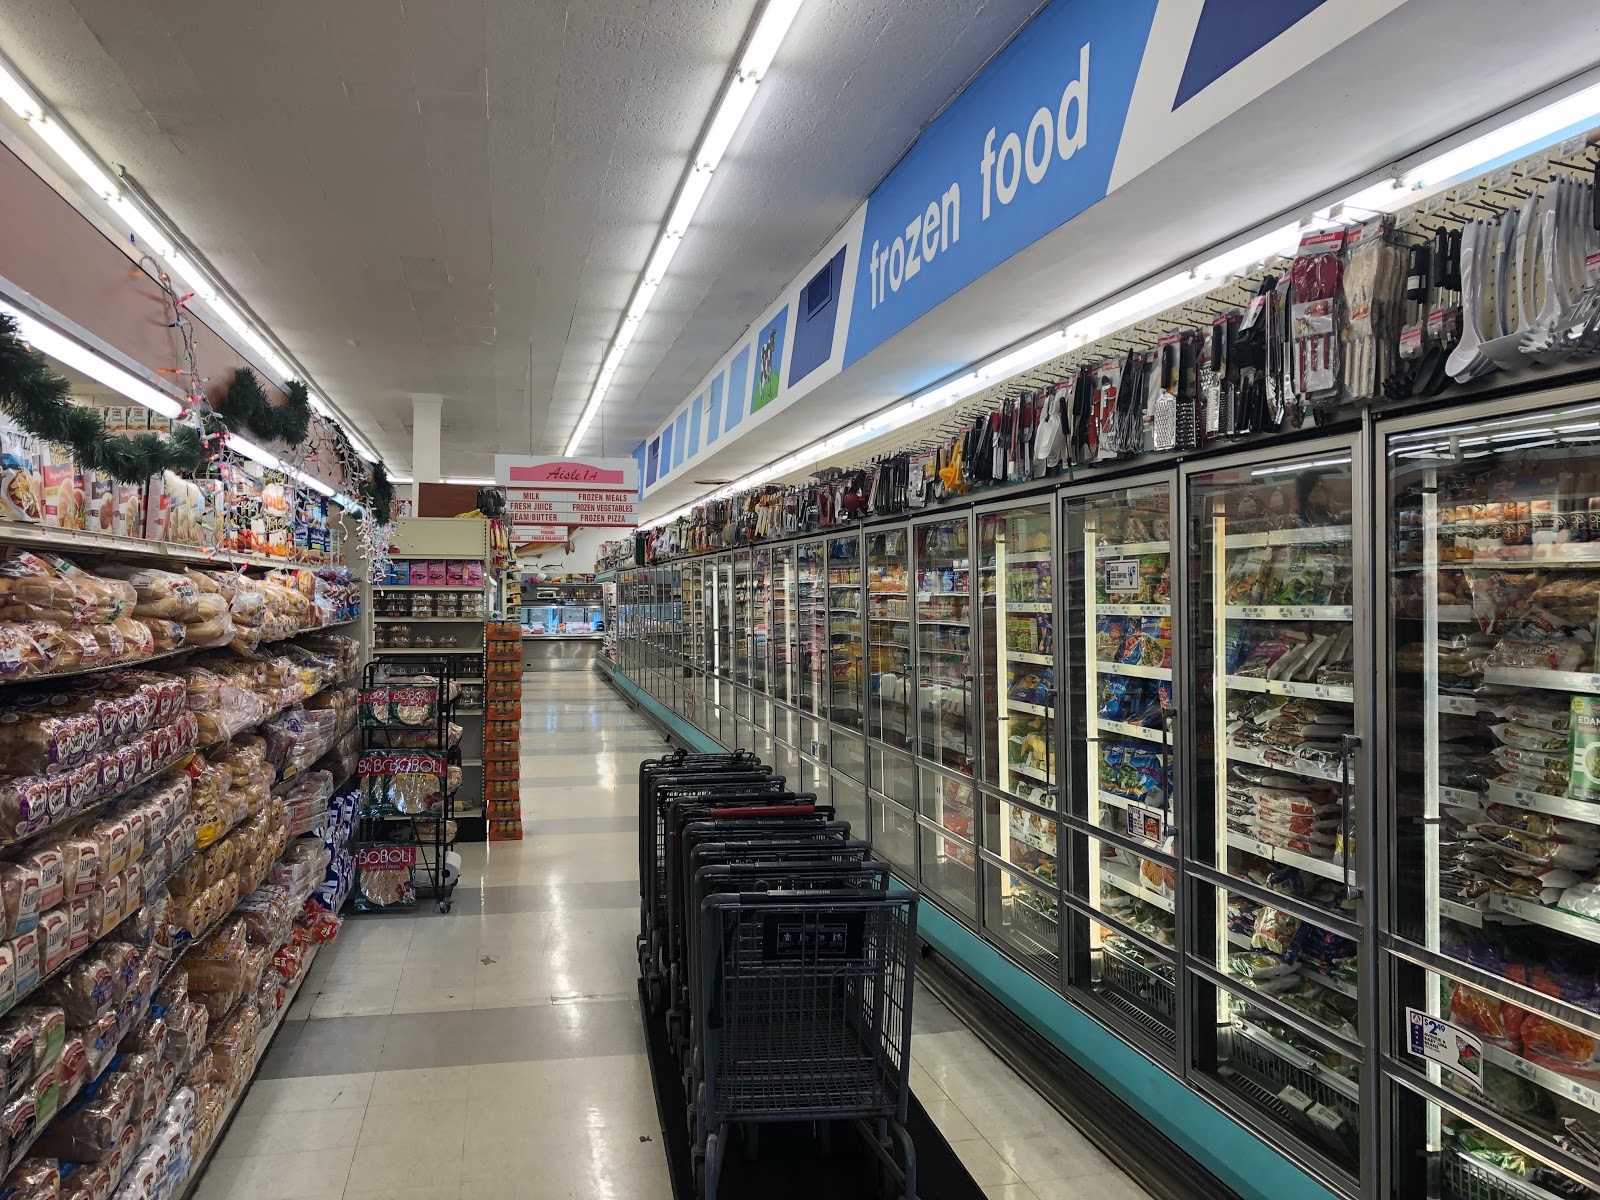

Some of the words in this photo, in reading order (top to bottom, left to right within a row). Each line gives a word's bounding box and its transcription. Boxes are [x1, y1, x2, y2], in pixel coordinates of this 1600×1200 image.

[869, 182, 960, 311] frozen
[980, 41, 1090, 221] food
[546, 467, 581, 481] Aisle
[523, 492, 540, 500] MILK
[578, 493, 603, 502] FROZEN
[605, 494, 628, 502] MEALS
[510, 502, 532, 511] FRESH
[534, 503, 553, 511] JUICE
[572, 503, 596, 512] FROZEN
[597, 504, 633, 512] VEGETABLES
[507, 513, 558, 522] REAM/BUTTER
[580, 514, 605, 522] FROZEN
[607, 515, 626, 523] PIZZA
